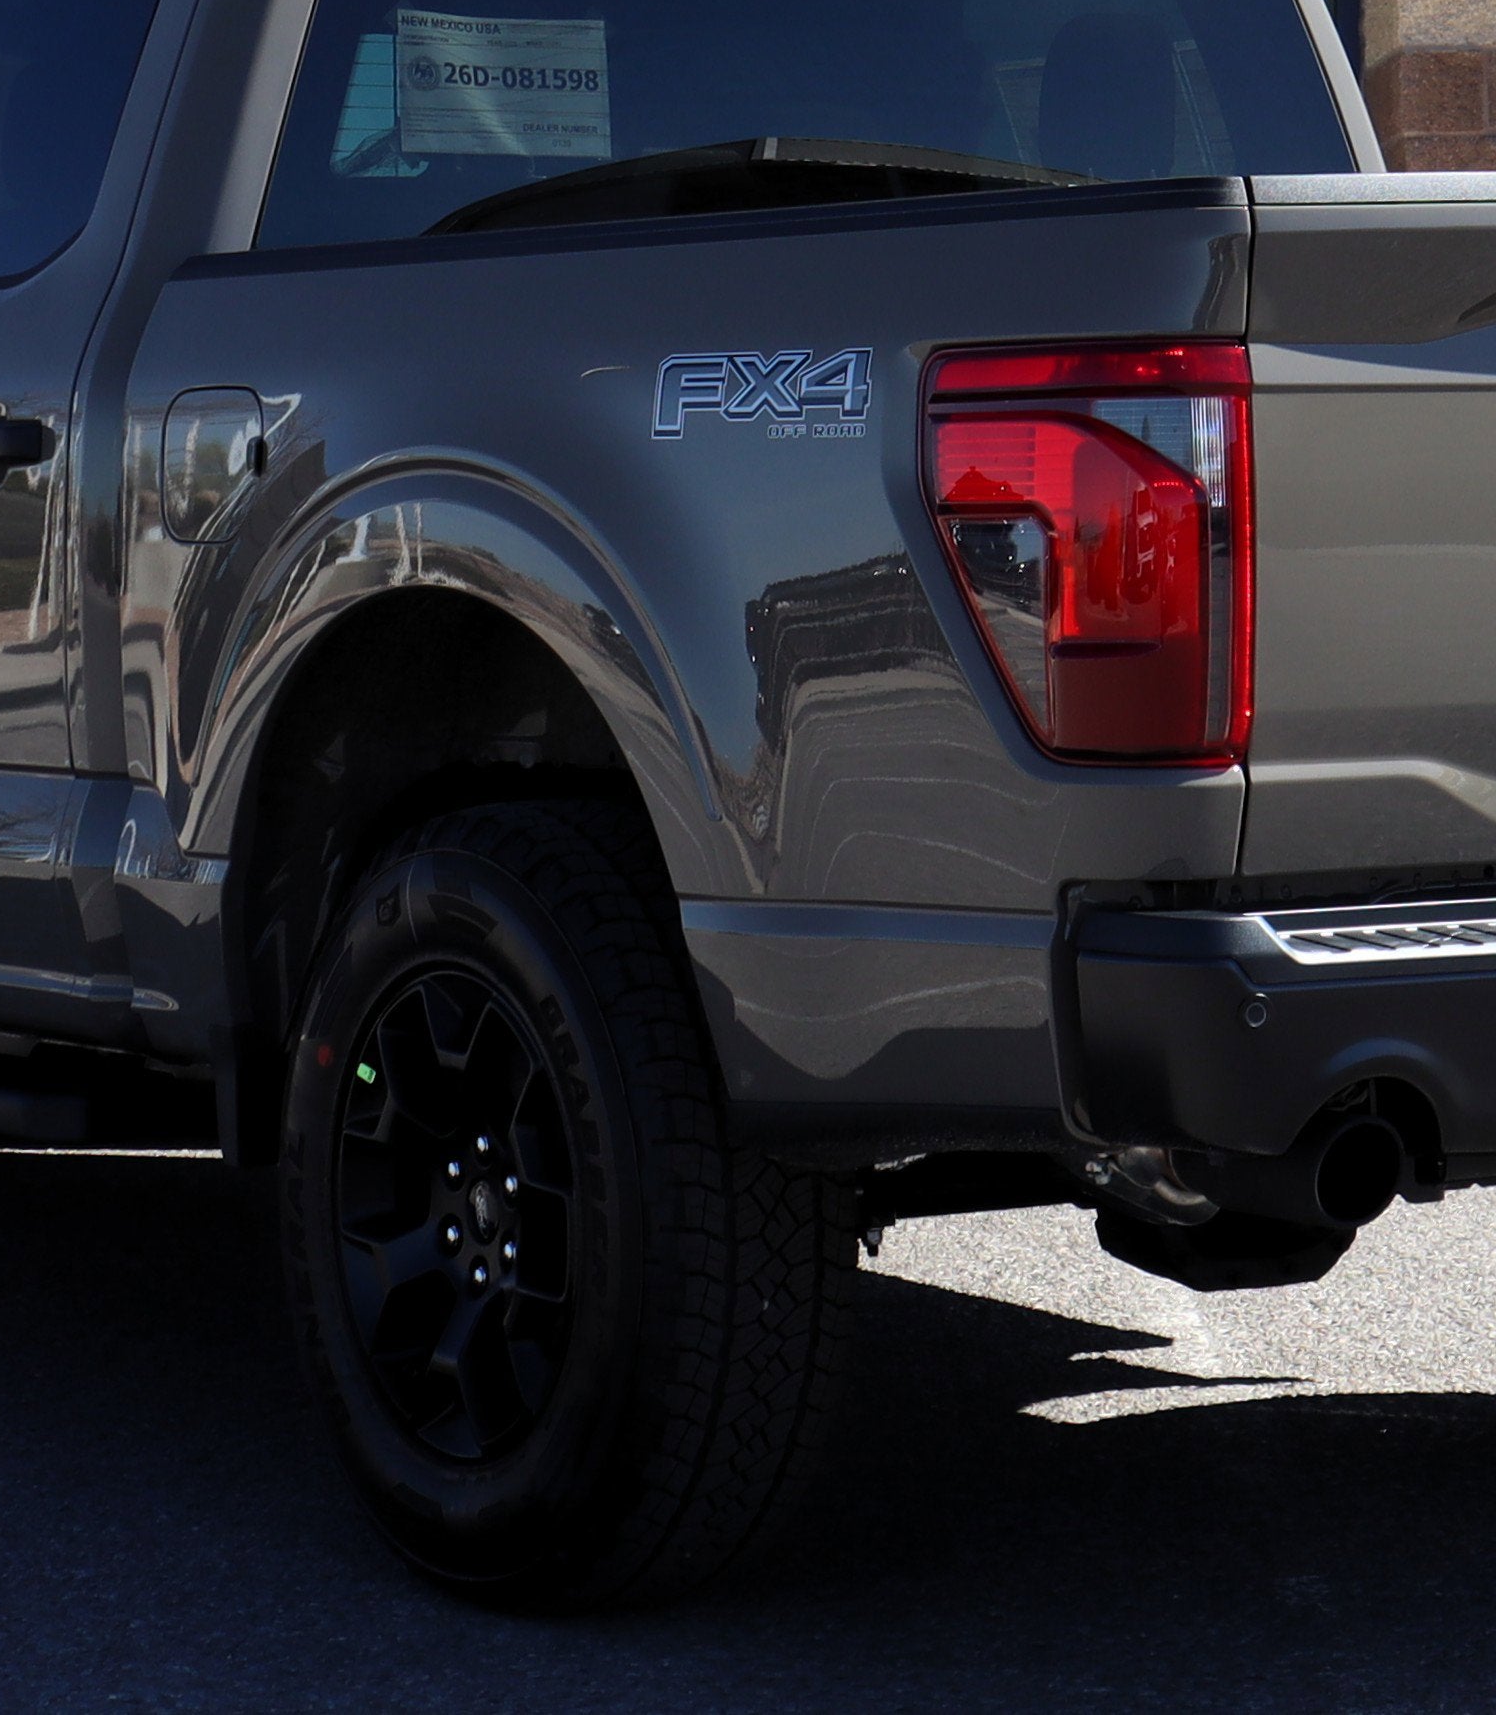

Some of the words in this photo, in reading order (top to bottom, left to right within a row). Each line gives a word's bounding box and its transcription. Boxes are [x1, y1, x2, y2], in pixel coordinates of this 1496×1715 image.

[401, 15, 429, 28] NEW
[431, 18, 473, 33] MEXICO
[475, 22, 502, 34] USA
[444, 62, 600, 92] 26D-081598
[523, 123, 559, 134] DEALER
[560, 124, 599, 135] NUMBER
[651, 347, 873, 440] FX4
[767, 424, 807, 439] OFF
[812, 423, 866, 438] ROAD
